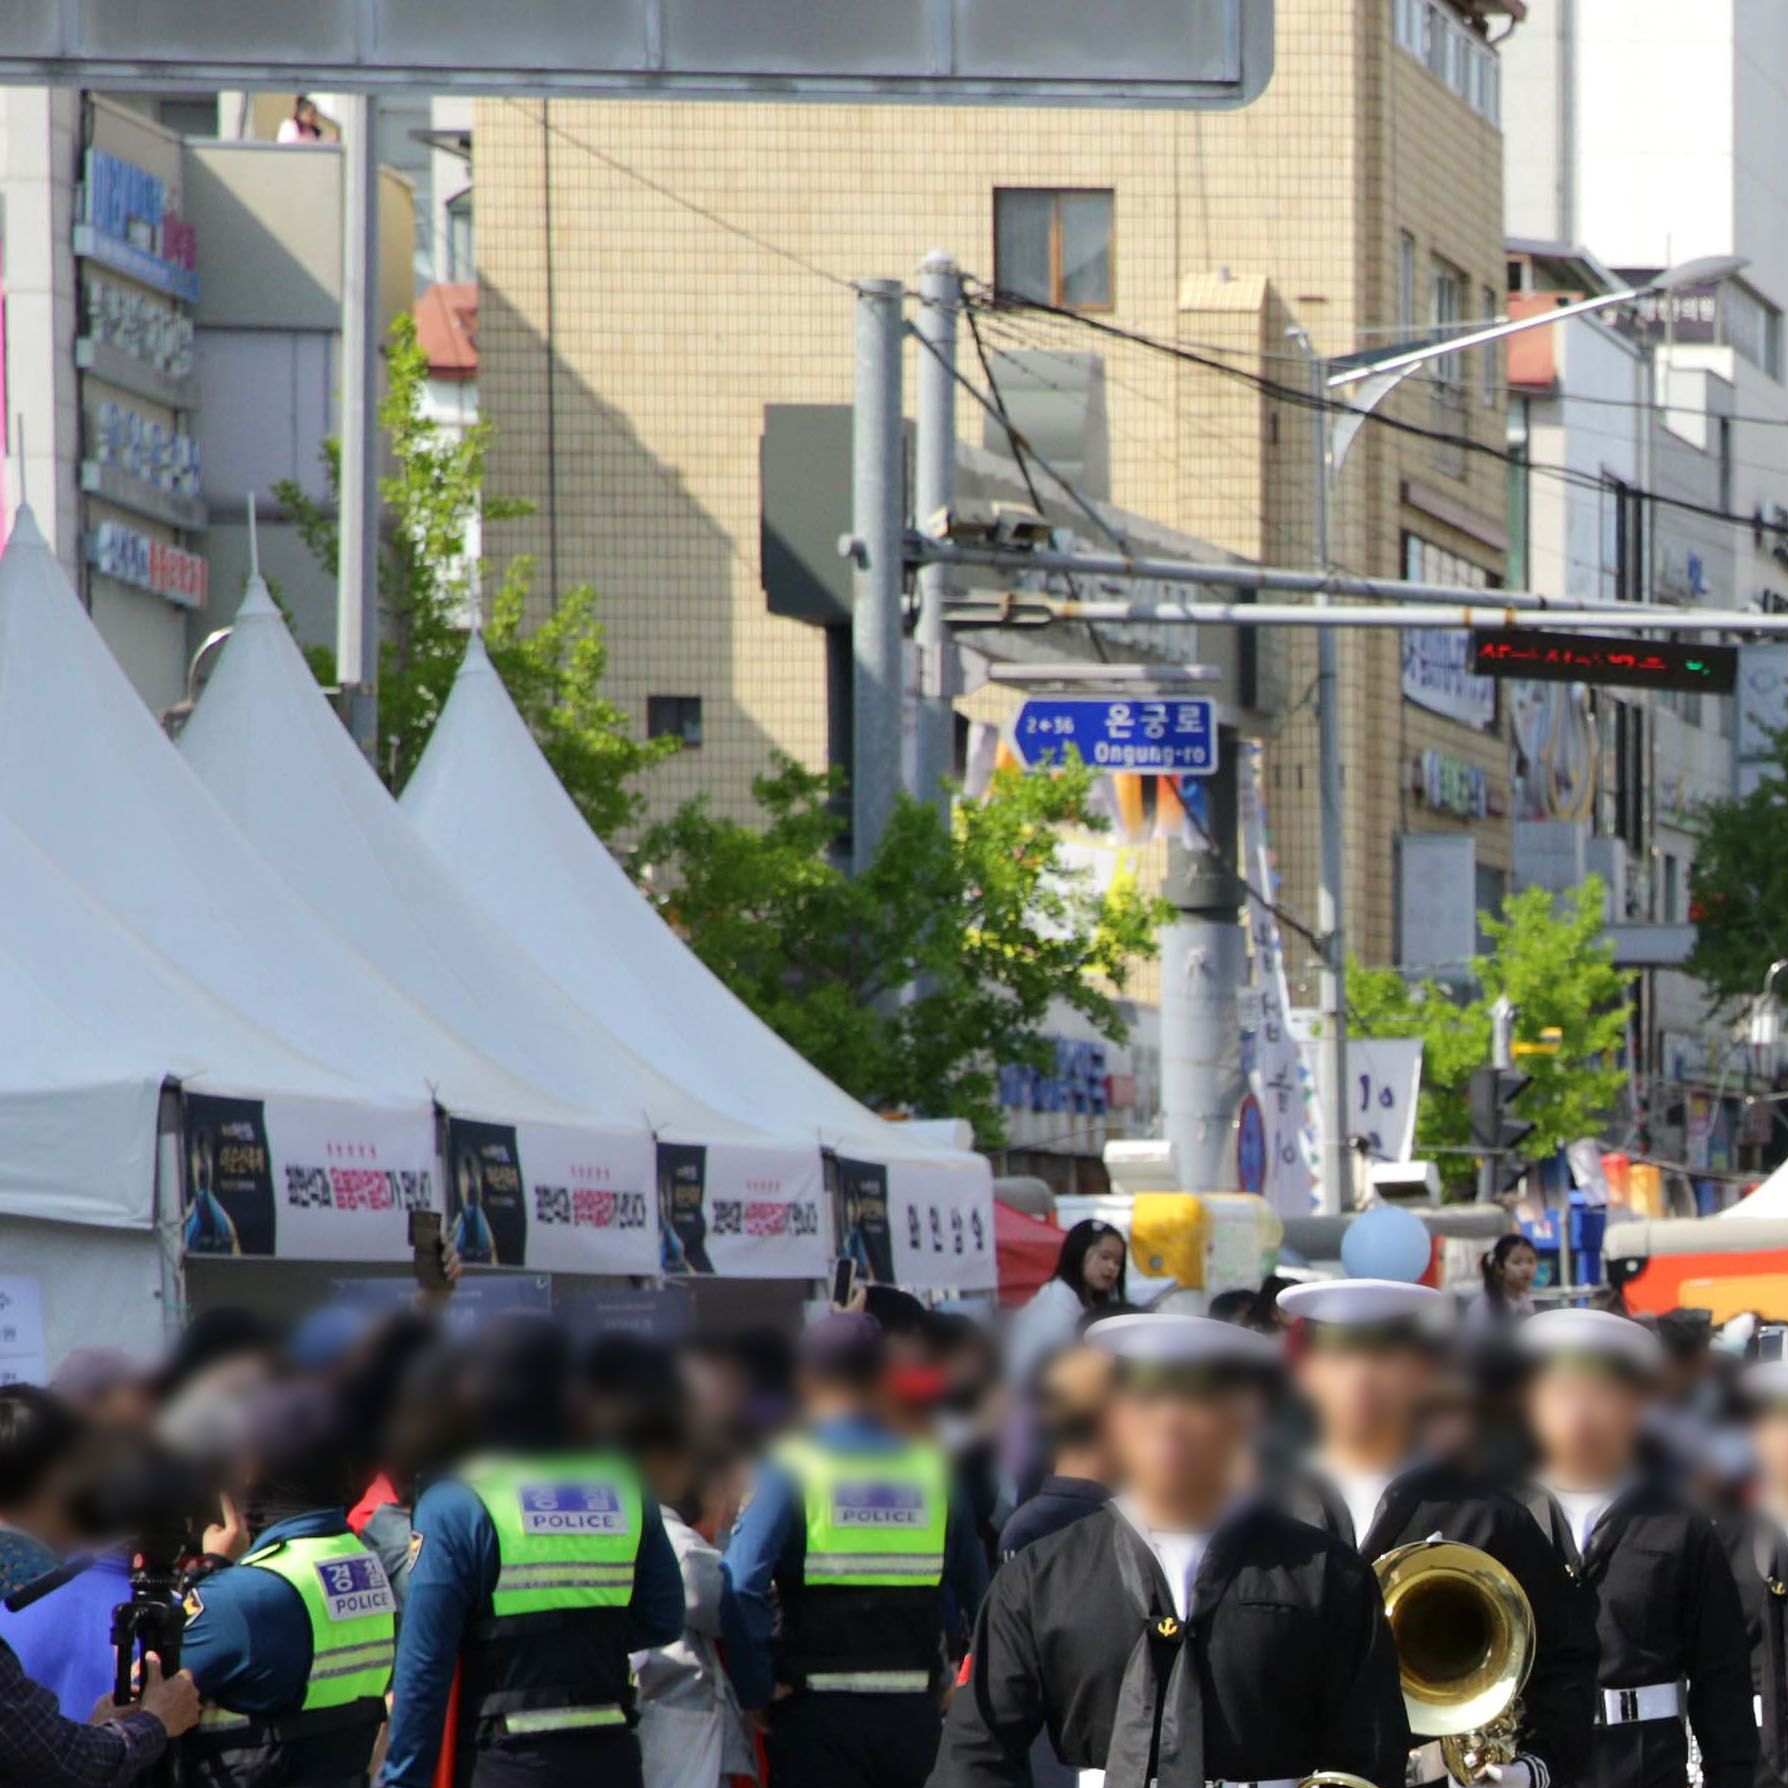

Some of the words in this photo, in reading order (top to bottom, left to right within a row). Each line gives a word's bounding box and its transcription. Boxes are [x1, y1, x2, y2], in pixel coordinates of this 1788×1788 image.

[1104, 703, 1204, 739] 온궁로
[1094, 741, 1206, 767] Ongung-ro
[533, 1515, 616, 1528] POLICE
[327, 1559, 386, 1592] 경찰
[336, 1593, 388, 1614] POLICE
